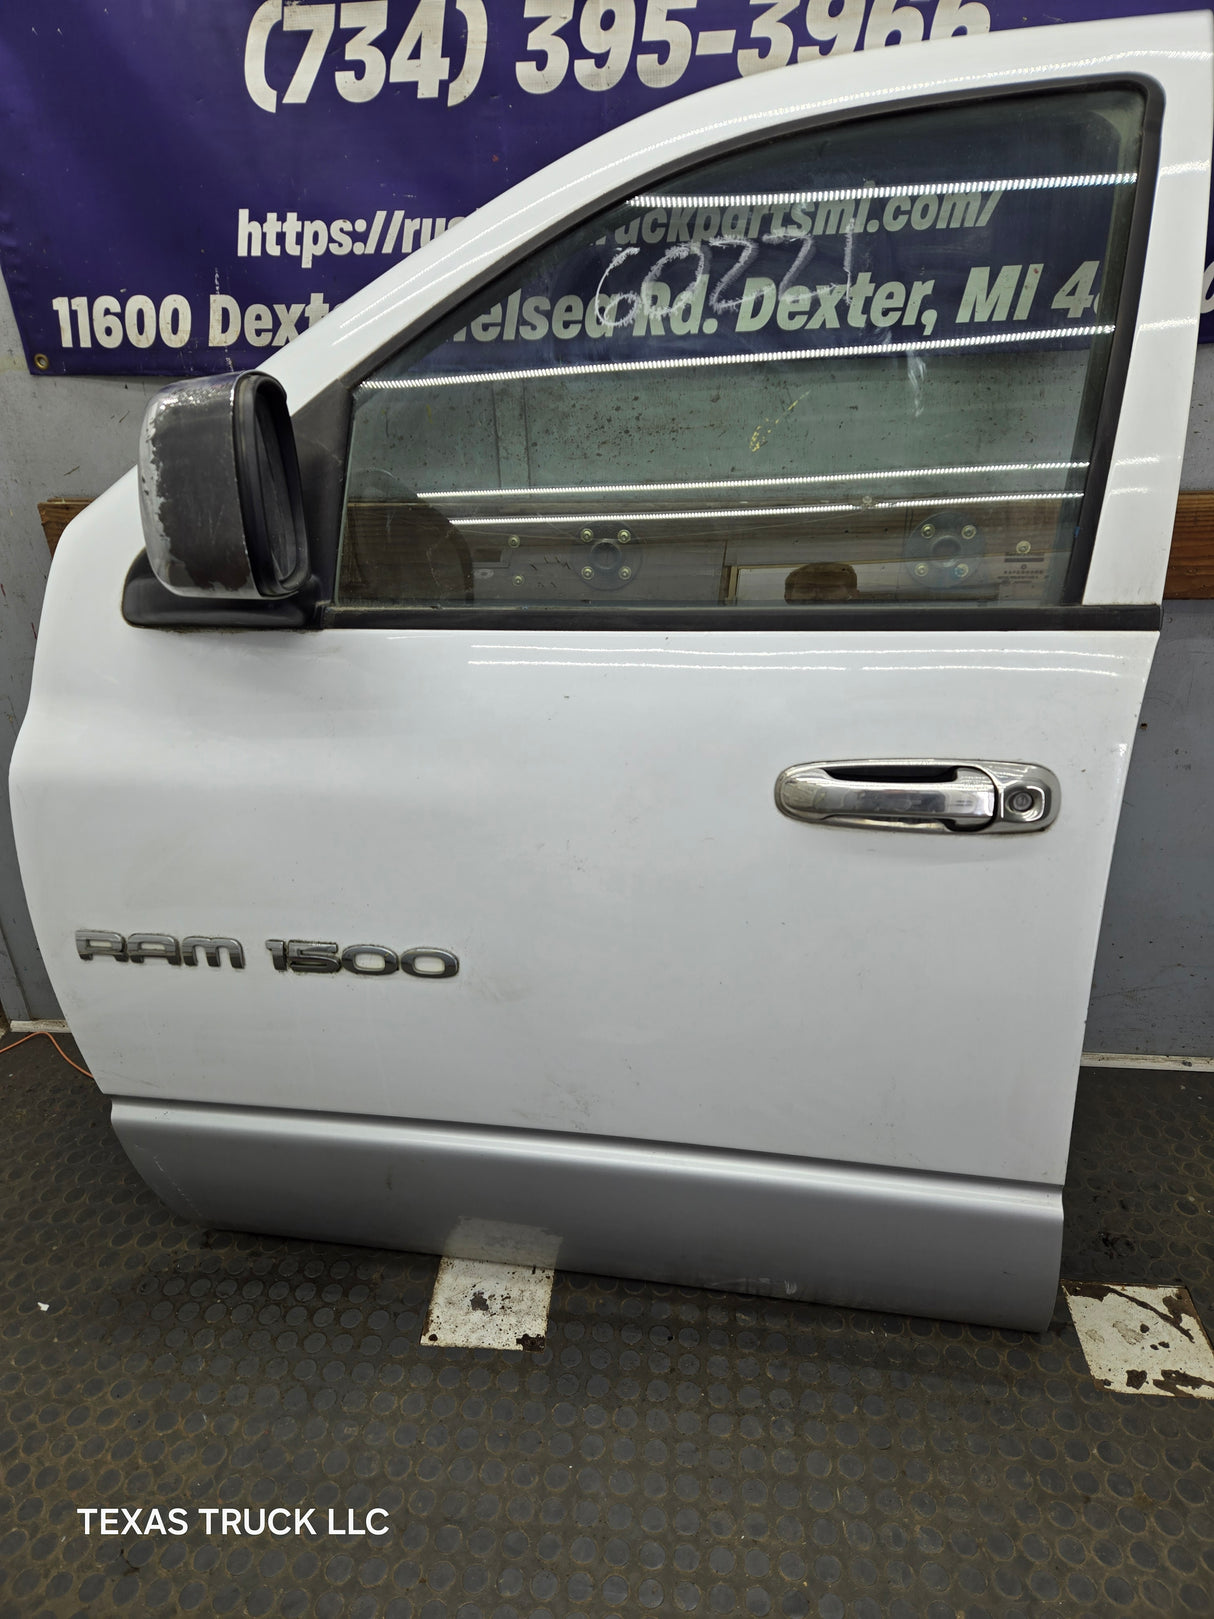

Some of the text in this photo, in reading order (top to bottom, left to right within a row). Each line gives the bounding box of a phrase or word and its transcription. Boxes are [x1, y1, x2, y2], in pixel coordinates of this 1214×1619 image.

[245, 0, 488, 113] (734)
[595, 182, 1002, 248] uckpartsmi.com/
[52, 260, 1101, 349] 11600 Dext elsea Rd. Dexter, MI 4
[75, 928, 460, 979] RAM 1500
